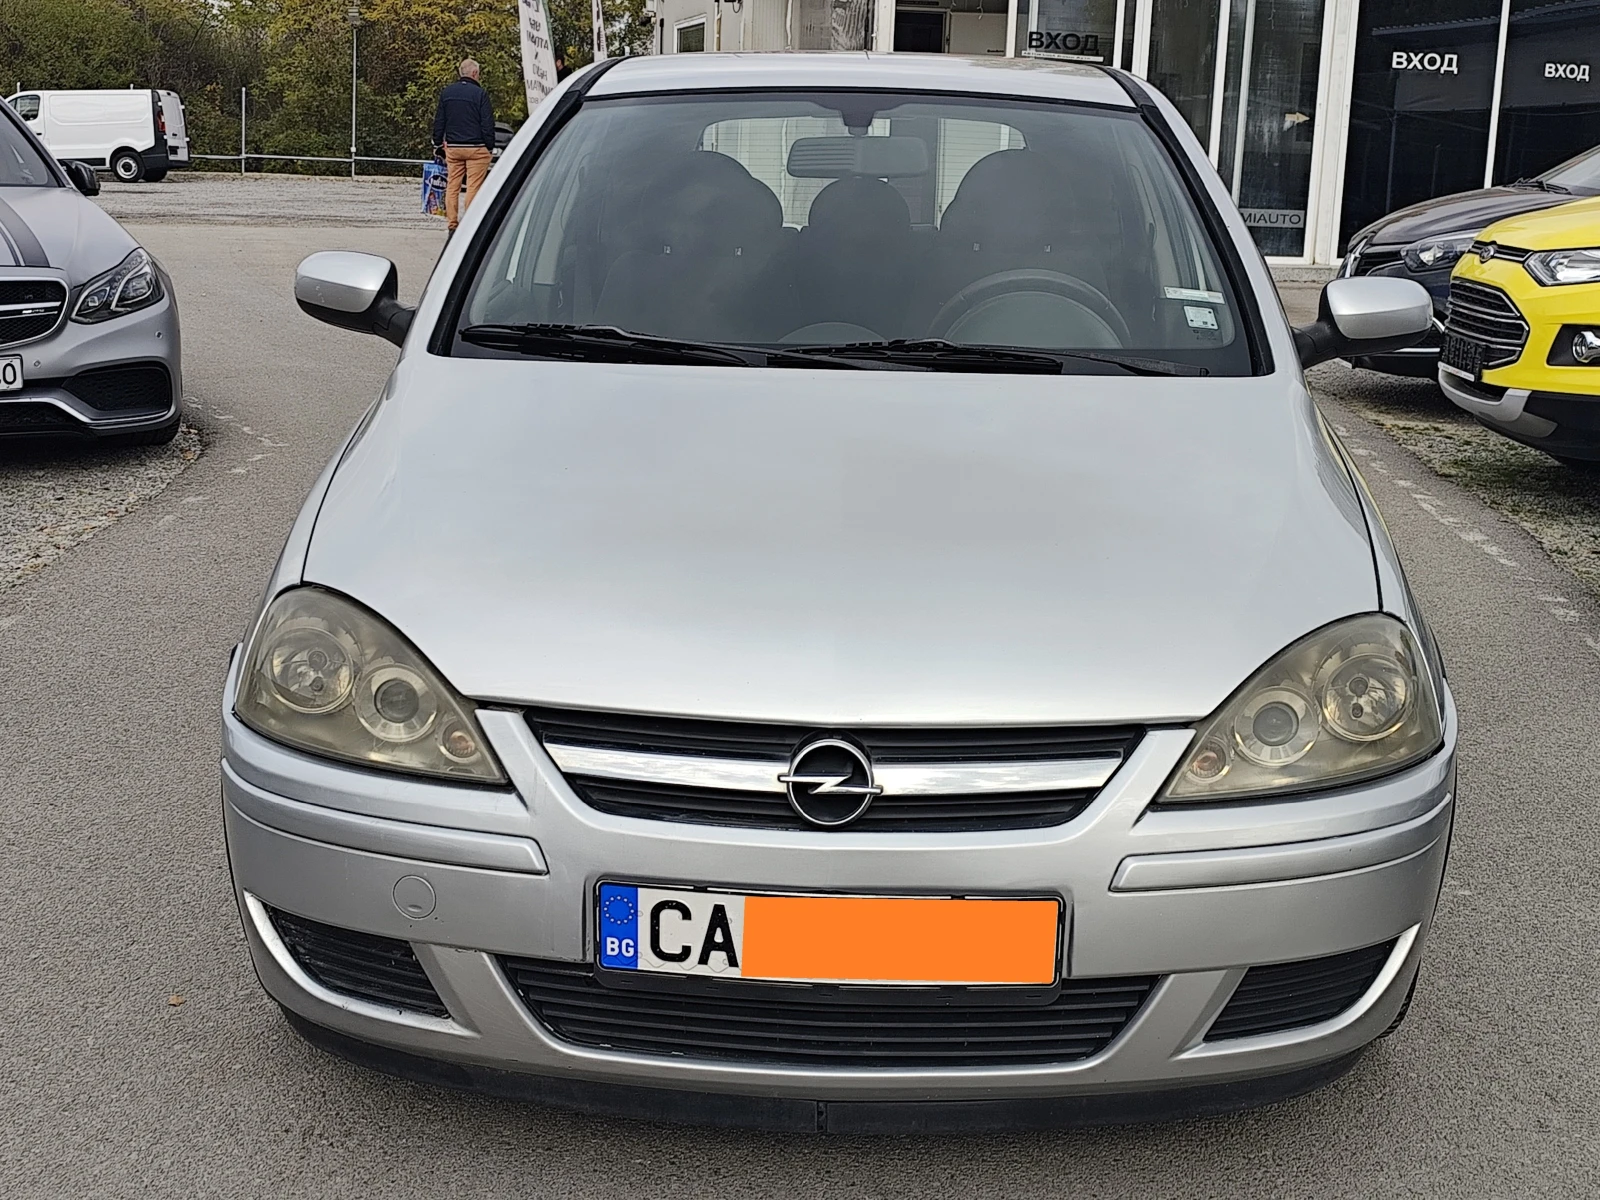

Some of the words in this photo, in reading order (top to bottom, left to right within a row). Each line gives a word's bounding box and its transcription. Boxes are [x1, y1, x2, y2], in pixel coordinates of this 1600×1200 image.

[1028, 31, 1099, 55] ВХОД
[1391, 51, 1458, 75] ВХОД
[1544, 63, 1590, 82] ВХОД
[650, 899, 740, 968] CA
[606, 936, 635, 957] BG
